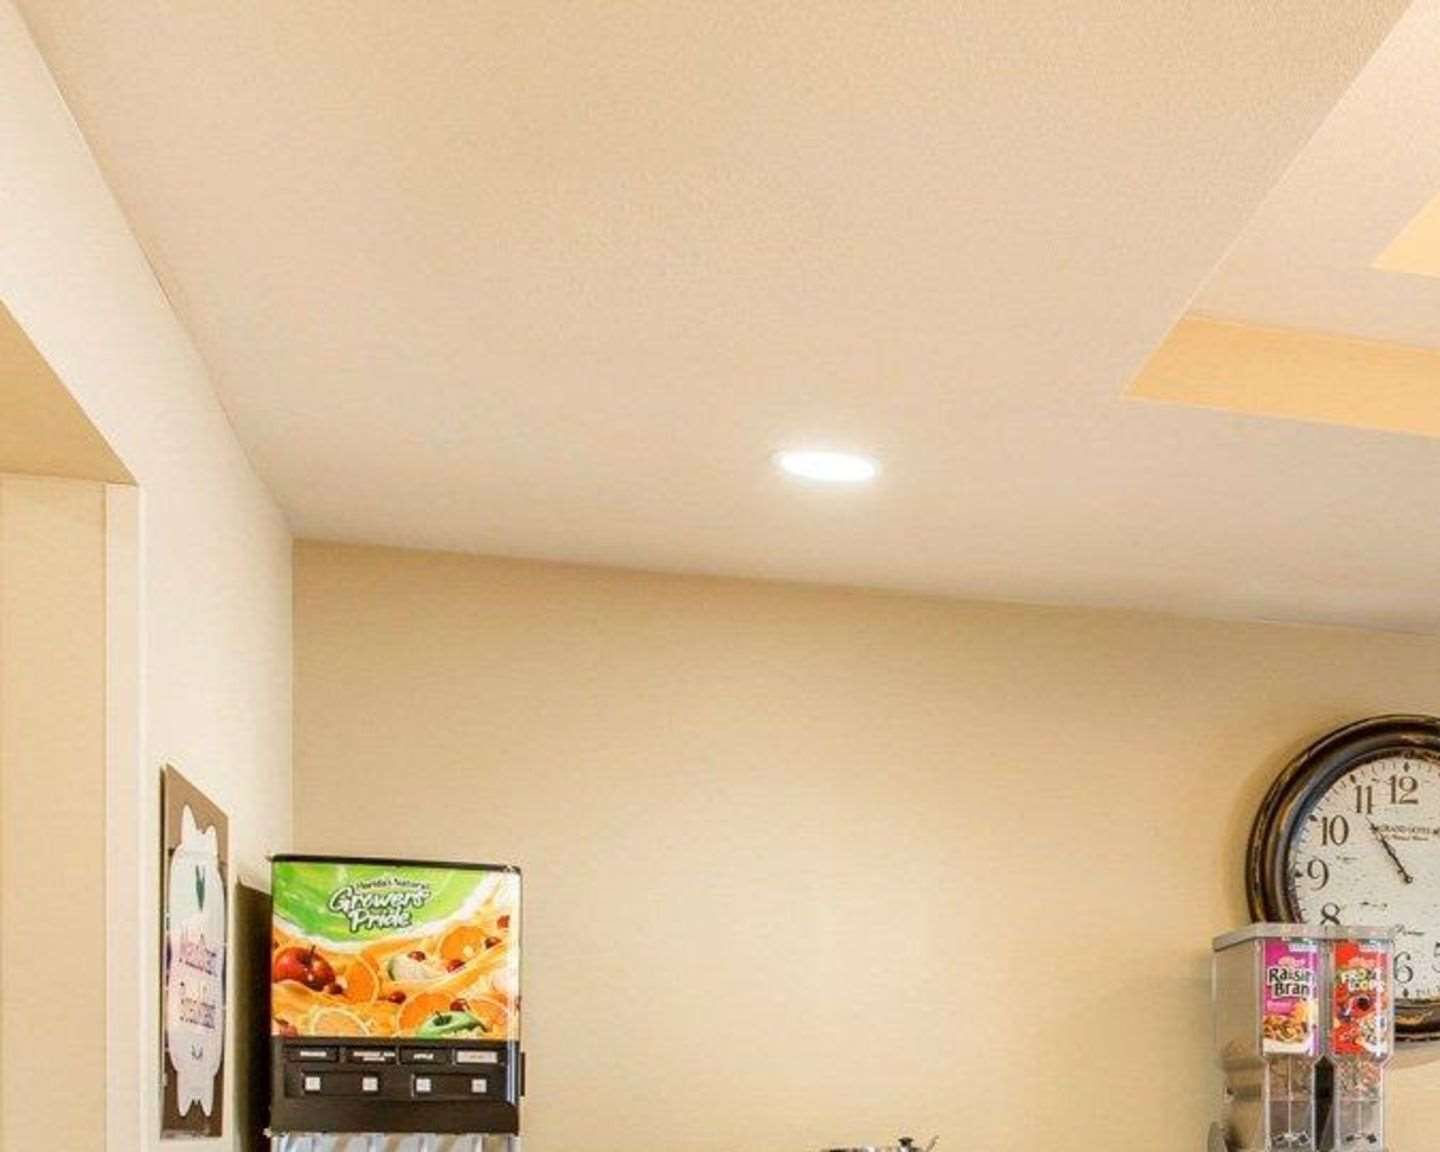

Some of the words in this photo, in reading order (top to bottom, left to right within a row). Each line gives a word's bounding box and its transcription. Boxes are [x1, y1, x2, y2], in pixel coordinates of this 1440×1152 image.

[1354, 785, 1373, 814] 11
[1389, 774, 1419, 805] 12
[1320, 815, 1349, 846] 10
[1307, 856, 1329, 892] 9
[349, 906, 413, 933] Pride
[1321, 902, 1340, 926] 8
[1393, 951, 1413, 984] 6
[1274, 981, 1312, 998] Bran
